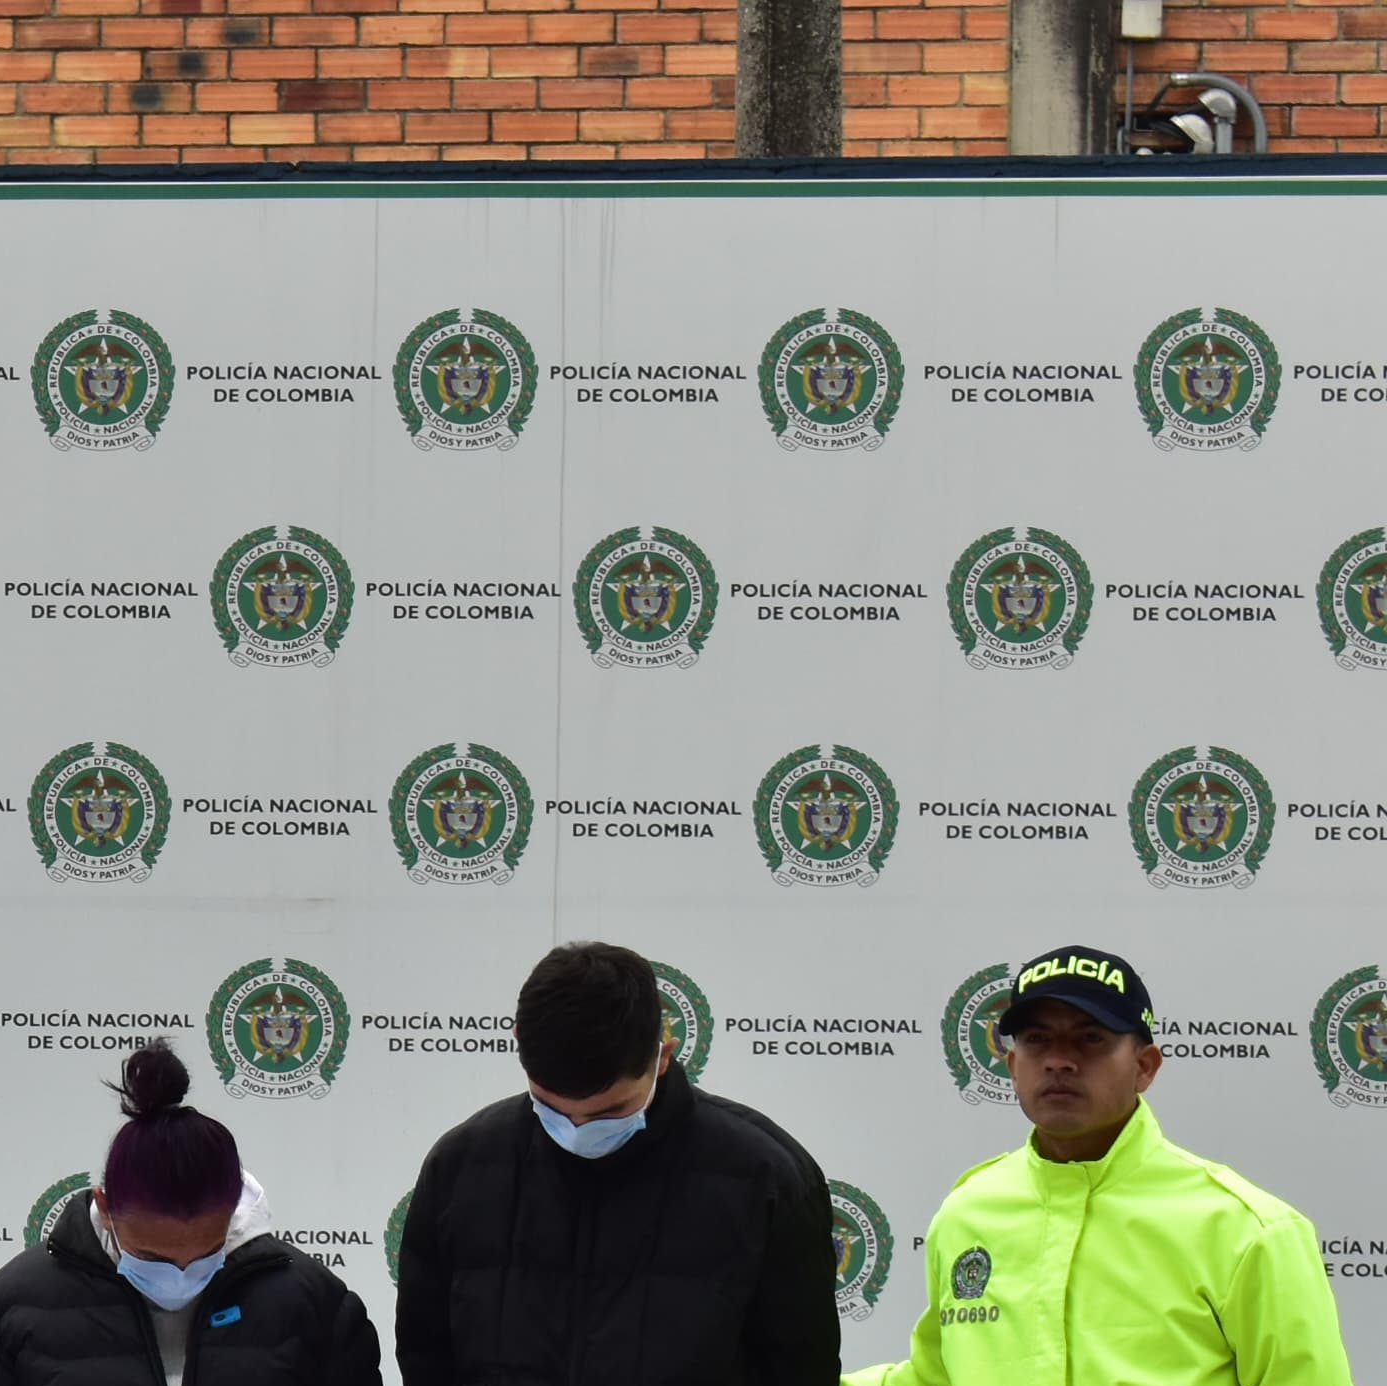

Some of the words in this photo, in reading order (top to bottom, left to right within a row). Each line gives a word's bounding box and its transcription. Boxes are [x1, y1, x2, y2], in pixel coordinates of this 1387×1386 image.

[187, 362, 267, 380] POLICÍA
[274, 366, 382, 379] NACIONAL
[925, 361, 1006, 379] POLICÍA
[1013, 365, 1122, 379] NACIONAL
[214, 389, 239, 402] DE
[246, 389, 354, 402] COLOMBIA
[952, 389, 977, 402] DE
[984, 388, 1094, 402] COLOMBIA
[1014, 543, 1030, 551] DE
[1041, 549, 1076, 606] COLOMBIA
[367, 578, 447, 596] POLICÍA
[454, 583, 561, 597] NACIONAL
[1106, 580, 1187, 598] POLICÍA
[1195, 585, 1304, 598] NACIONAL
[394, 606, 419, 619] DE
[425, 606, 534, 619] COLOMBIA
[1133, 607, 1159, 621] DE
[1166, 607, 1276, 621] COLOMBIA
[1020, 618, 1071, 652] NACIONAL
[1020, 650, 1057, 666] PATRIA
[546, 796, 626, 814] POLICÍA
[633, 801, 742, 815] NACIONAL
[1288, 800, 1370, 818] POLICÍA
[573, 823, 598, 837] DE
[605, 823, 713, 837] COLOMBIA
[1315, 827, 1341, 840] DE
[1018, 955, 1125, 994] POLICÍA
[726, 1014, 807, 1032] POLICÍA
[814, 1019, 922, 1033] NACIONAL
[1189, 1022, 1298, 1035] NACIONAL
[753, 1041, 778, 1055] DE
[785, 1041, 894, 1055] COLOMBIA
[1161, 1044, 1270, 1058] COLOMBIA
